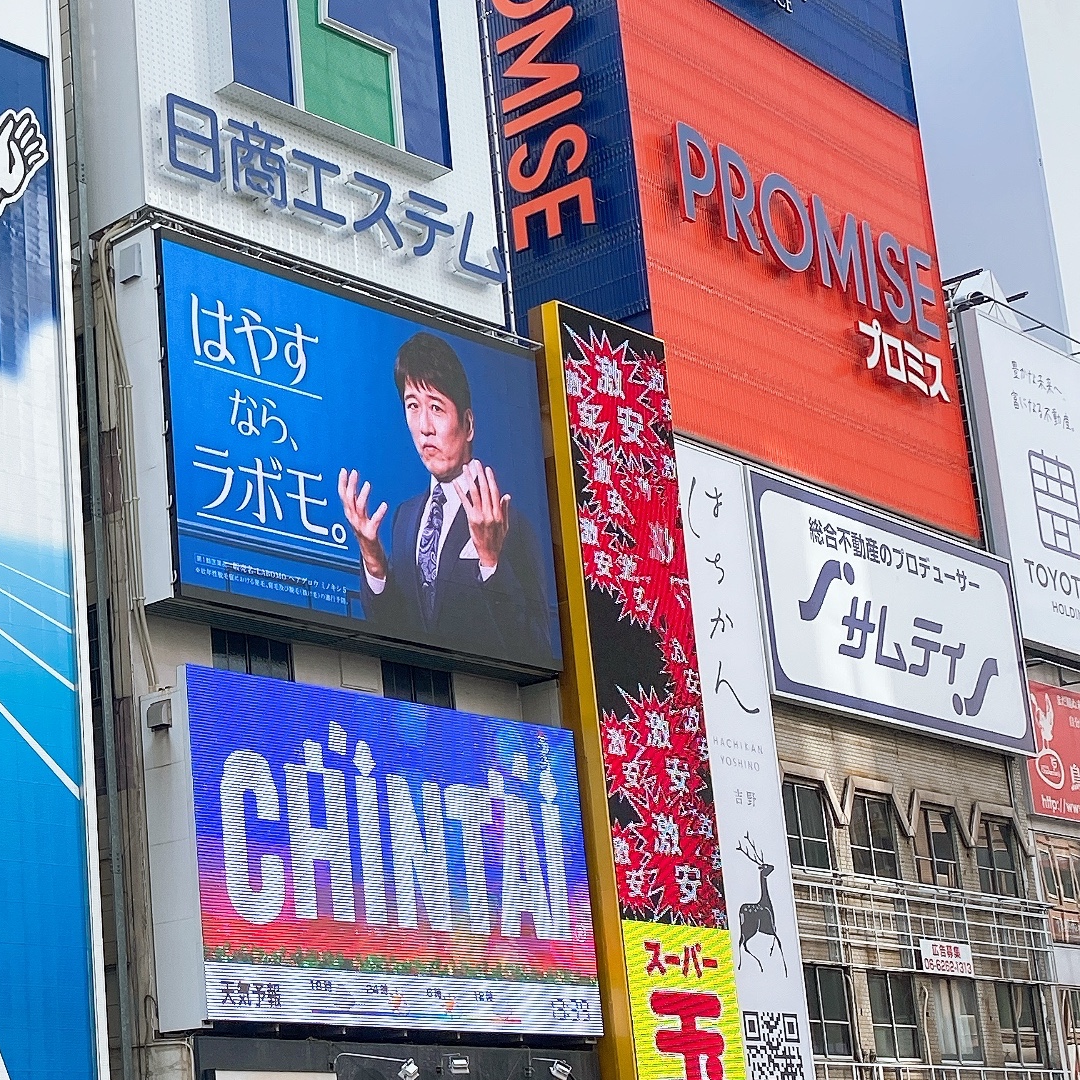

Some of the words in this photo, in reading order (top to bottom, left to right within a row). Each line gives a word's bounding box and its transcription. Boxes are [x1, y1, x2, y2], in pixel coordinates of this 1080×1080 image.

[492, 0, 596, 252] MISE
[166, 92, 506, 284] 日商エステム
[675, 120, 941, 342] PROMISE
[190, 292, 319, 386] はやす
[857, 318, 951, 403] プロミス
[228, 388, 299, 451] なら、
[192, 444, 348, 544] ラボモ。
[808, 516, 981, 592] 総合不動産のプロデューサー
[838, 596, 966, 685] サムティ
[713, 736, 764, 755] HACHIKAN
[720, 756, 761, 772] YOSHINO
[220, 720, 573, 941] CHINTAI
[643, 940, 718, 979] スーパー
[931, 944, 961, 959] 広告募集
